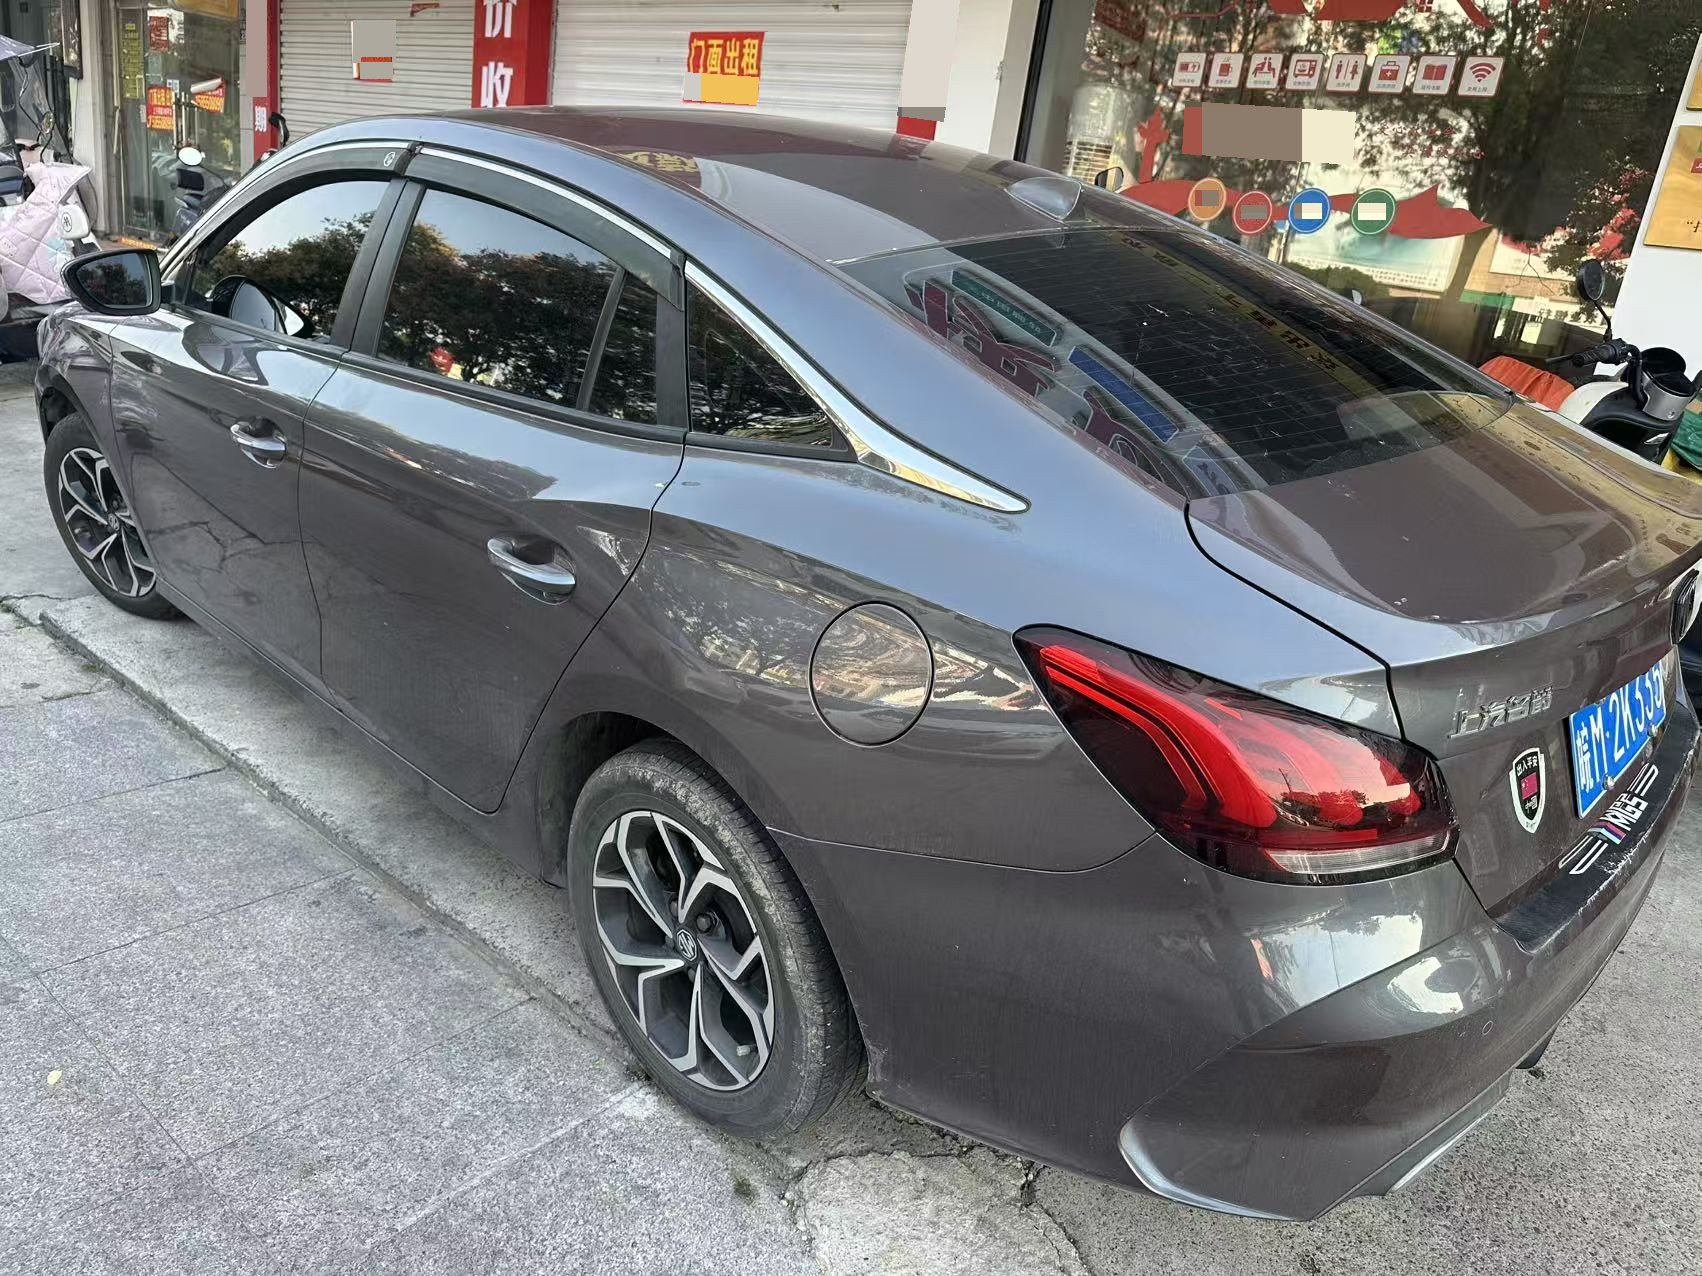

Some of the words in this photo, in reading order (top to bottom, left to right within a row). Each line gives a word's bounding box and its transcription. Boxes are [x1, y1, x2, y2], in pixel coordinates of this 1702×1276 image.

[689, 38, 759, 75] 门面出租
[1516, 755, 1538, 776] 出入平安
